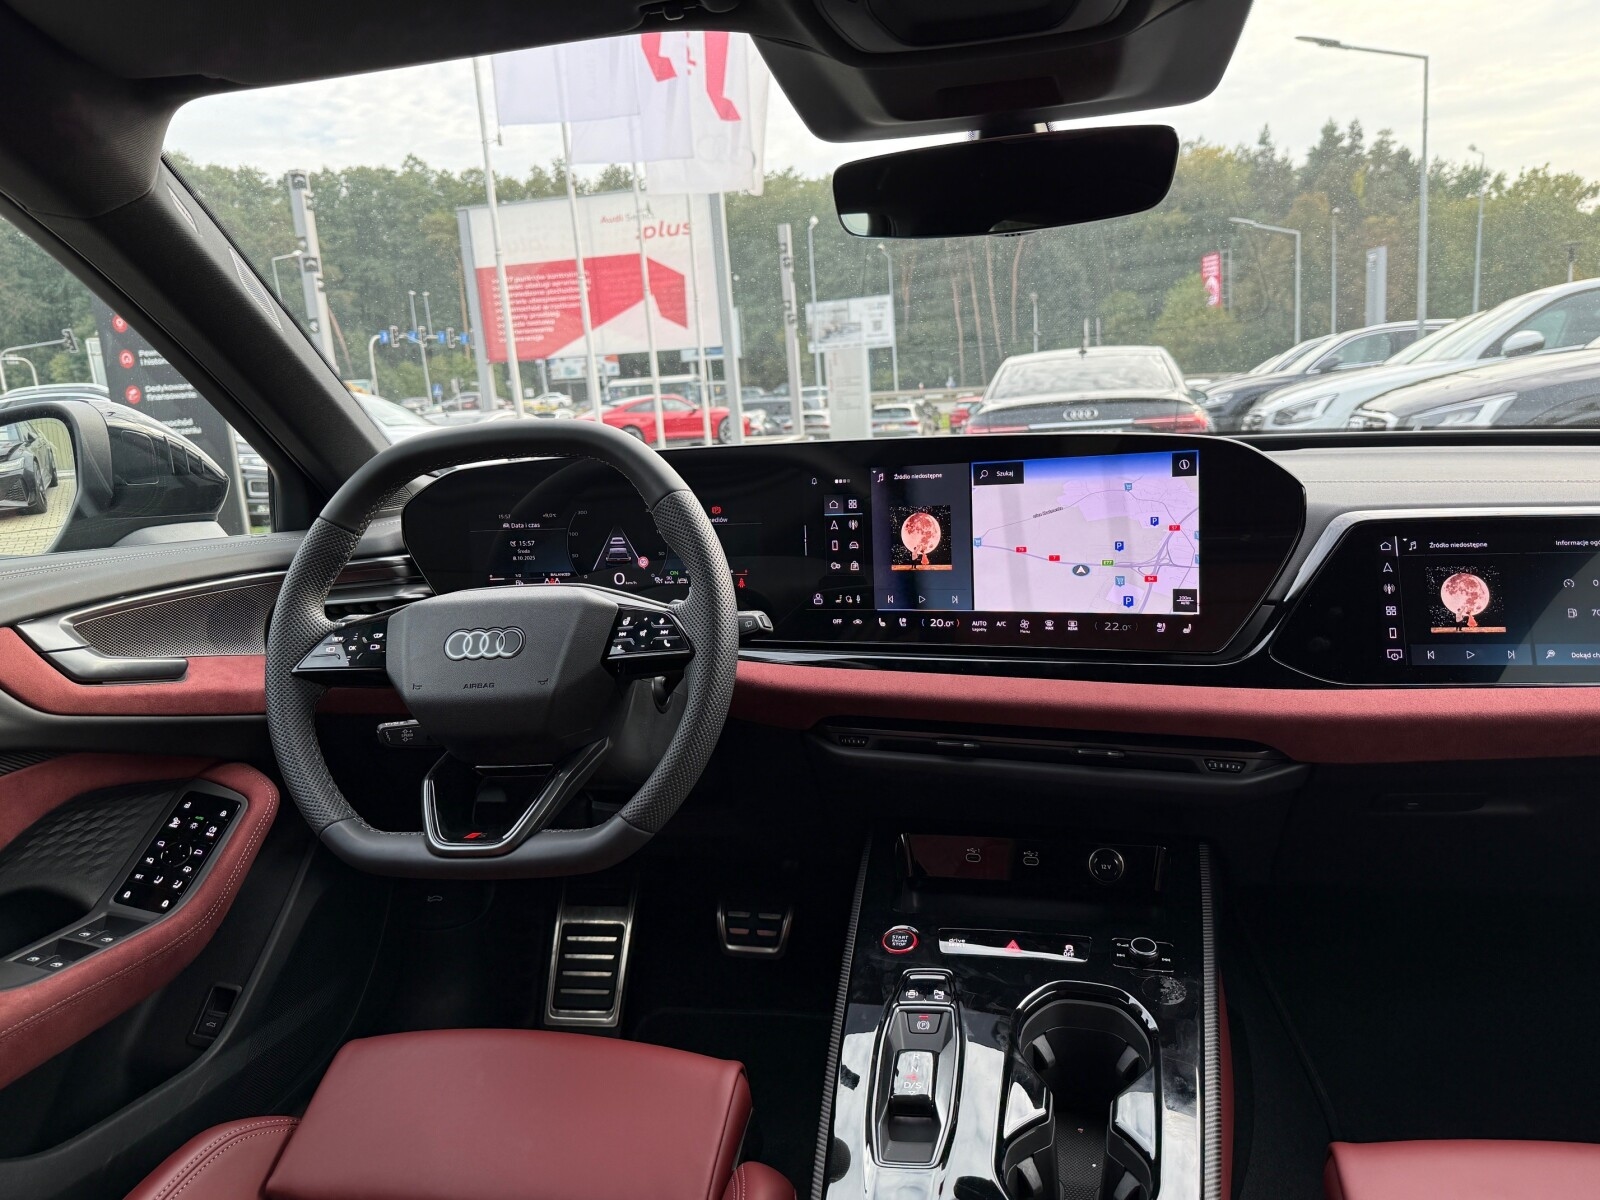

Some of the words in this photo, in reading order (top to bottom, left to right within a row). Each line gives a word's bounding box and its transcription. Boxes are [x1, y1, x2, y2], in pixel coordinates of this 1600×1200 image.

[911, 472, 942, 480] niedostępne
[1429, 540, 1449, 549] Źródło
[1450, 541, 1488, 549] niedostępne
[614, 572, 625, 586] 0
[1571, 652, 1591, 660] Dokąd
